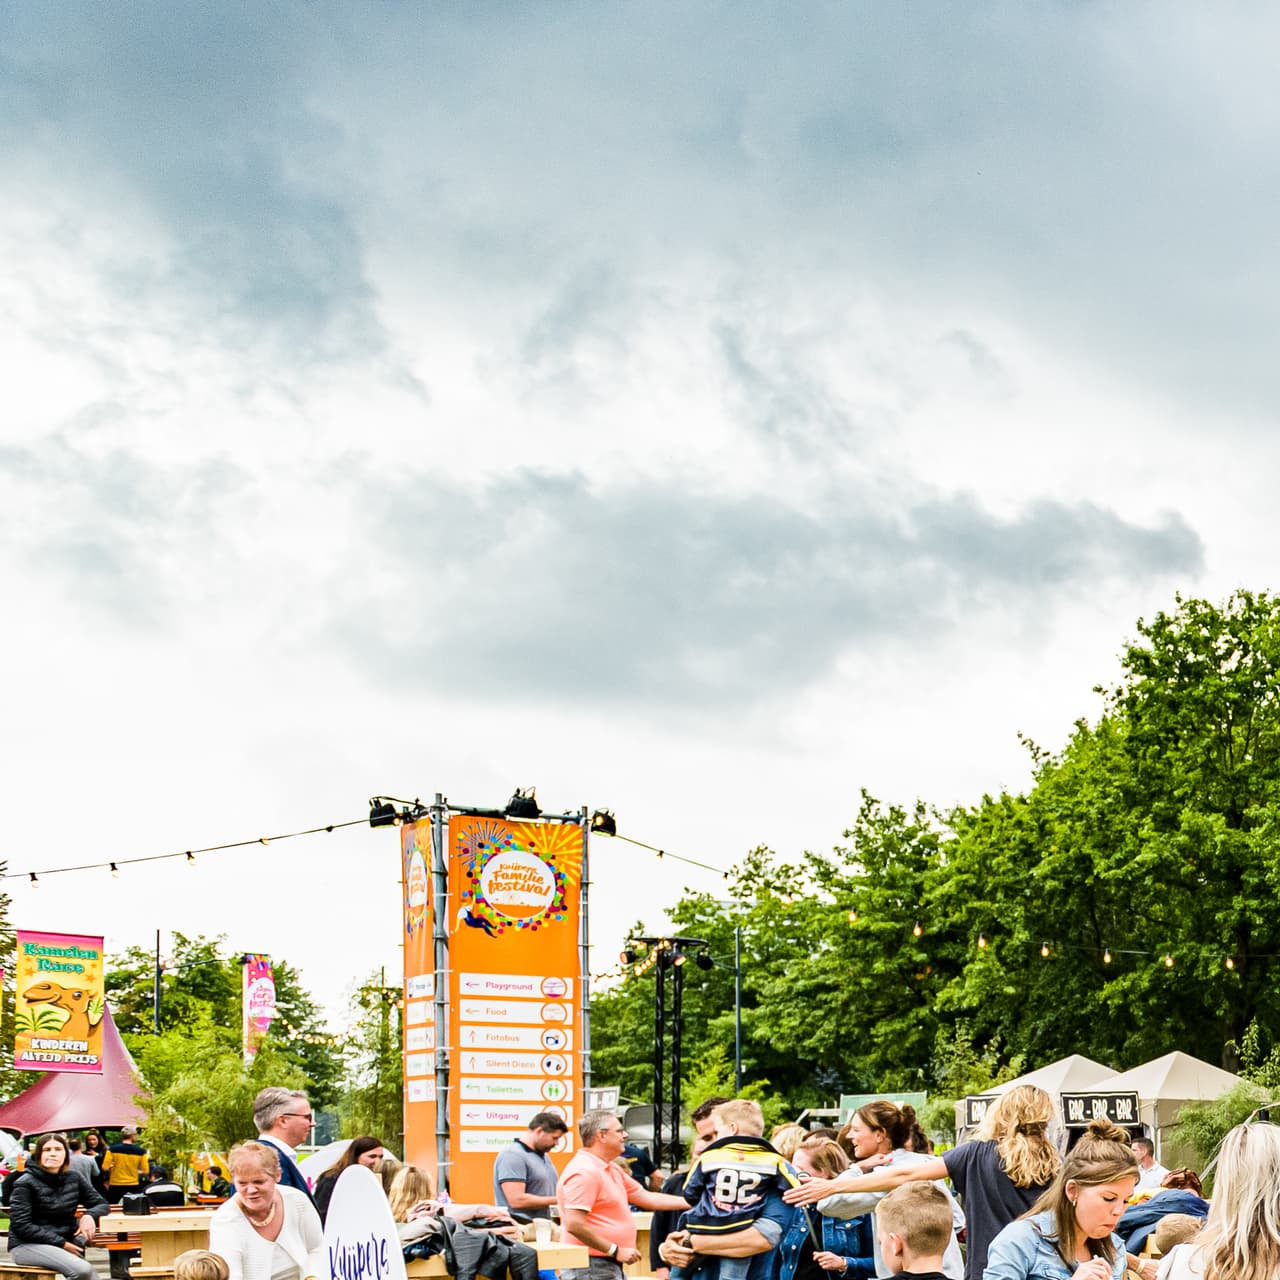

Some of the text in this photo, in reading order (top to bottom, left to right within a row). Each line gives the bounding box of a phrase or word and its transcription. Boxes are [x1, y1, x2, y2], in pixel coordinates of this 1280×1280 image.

[492, 869, 545, 885] Familie
[487, 879, 552, 897] festival
[37, 957, 85, 974] Race
[485, 981, 533, 991] Playground
[485, 1007, 507, 1016] Food
[486, 1033, 520, 1042] Fotobus
[31, 1038, 88, 1053] KINDEREN
[486, 1059, 535, 1069] Silent Disco
[486, 1111, 519, 1121] Uitgang
[1068, 1099, 1085, 1121] BAR
[1115, 1098, 1133, 1120] BAR
[715, 1168, 762, 1204] 82
